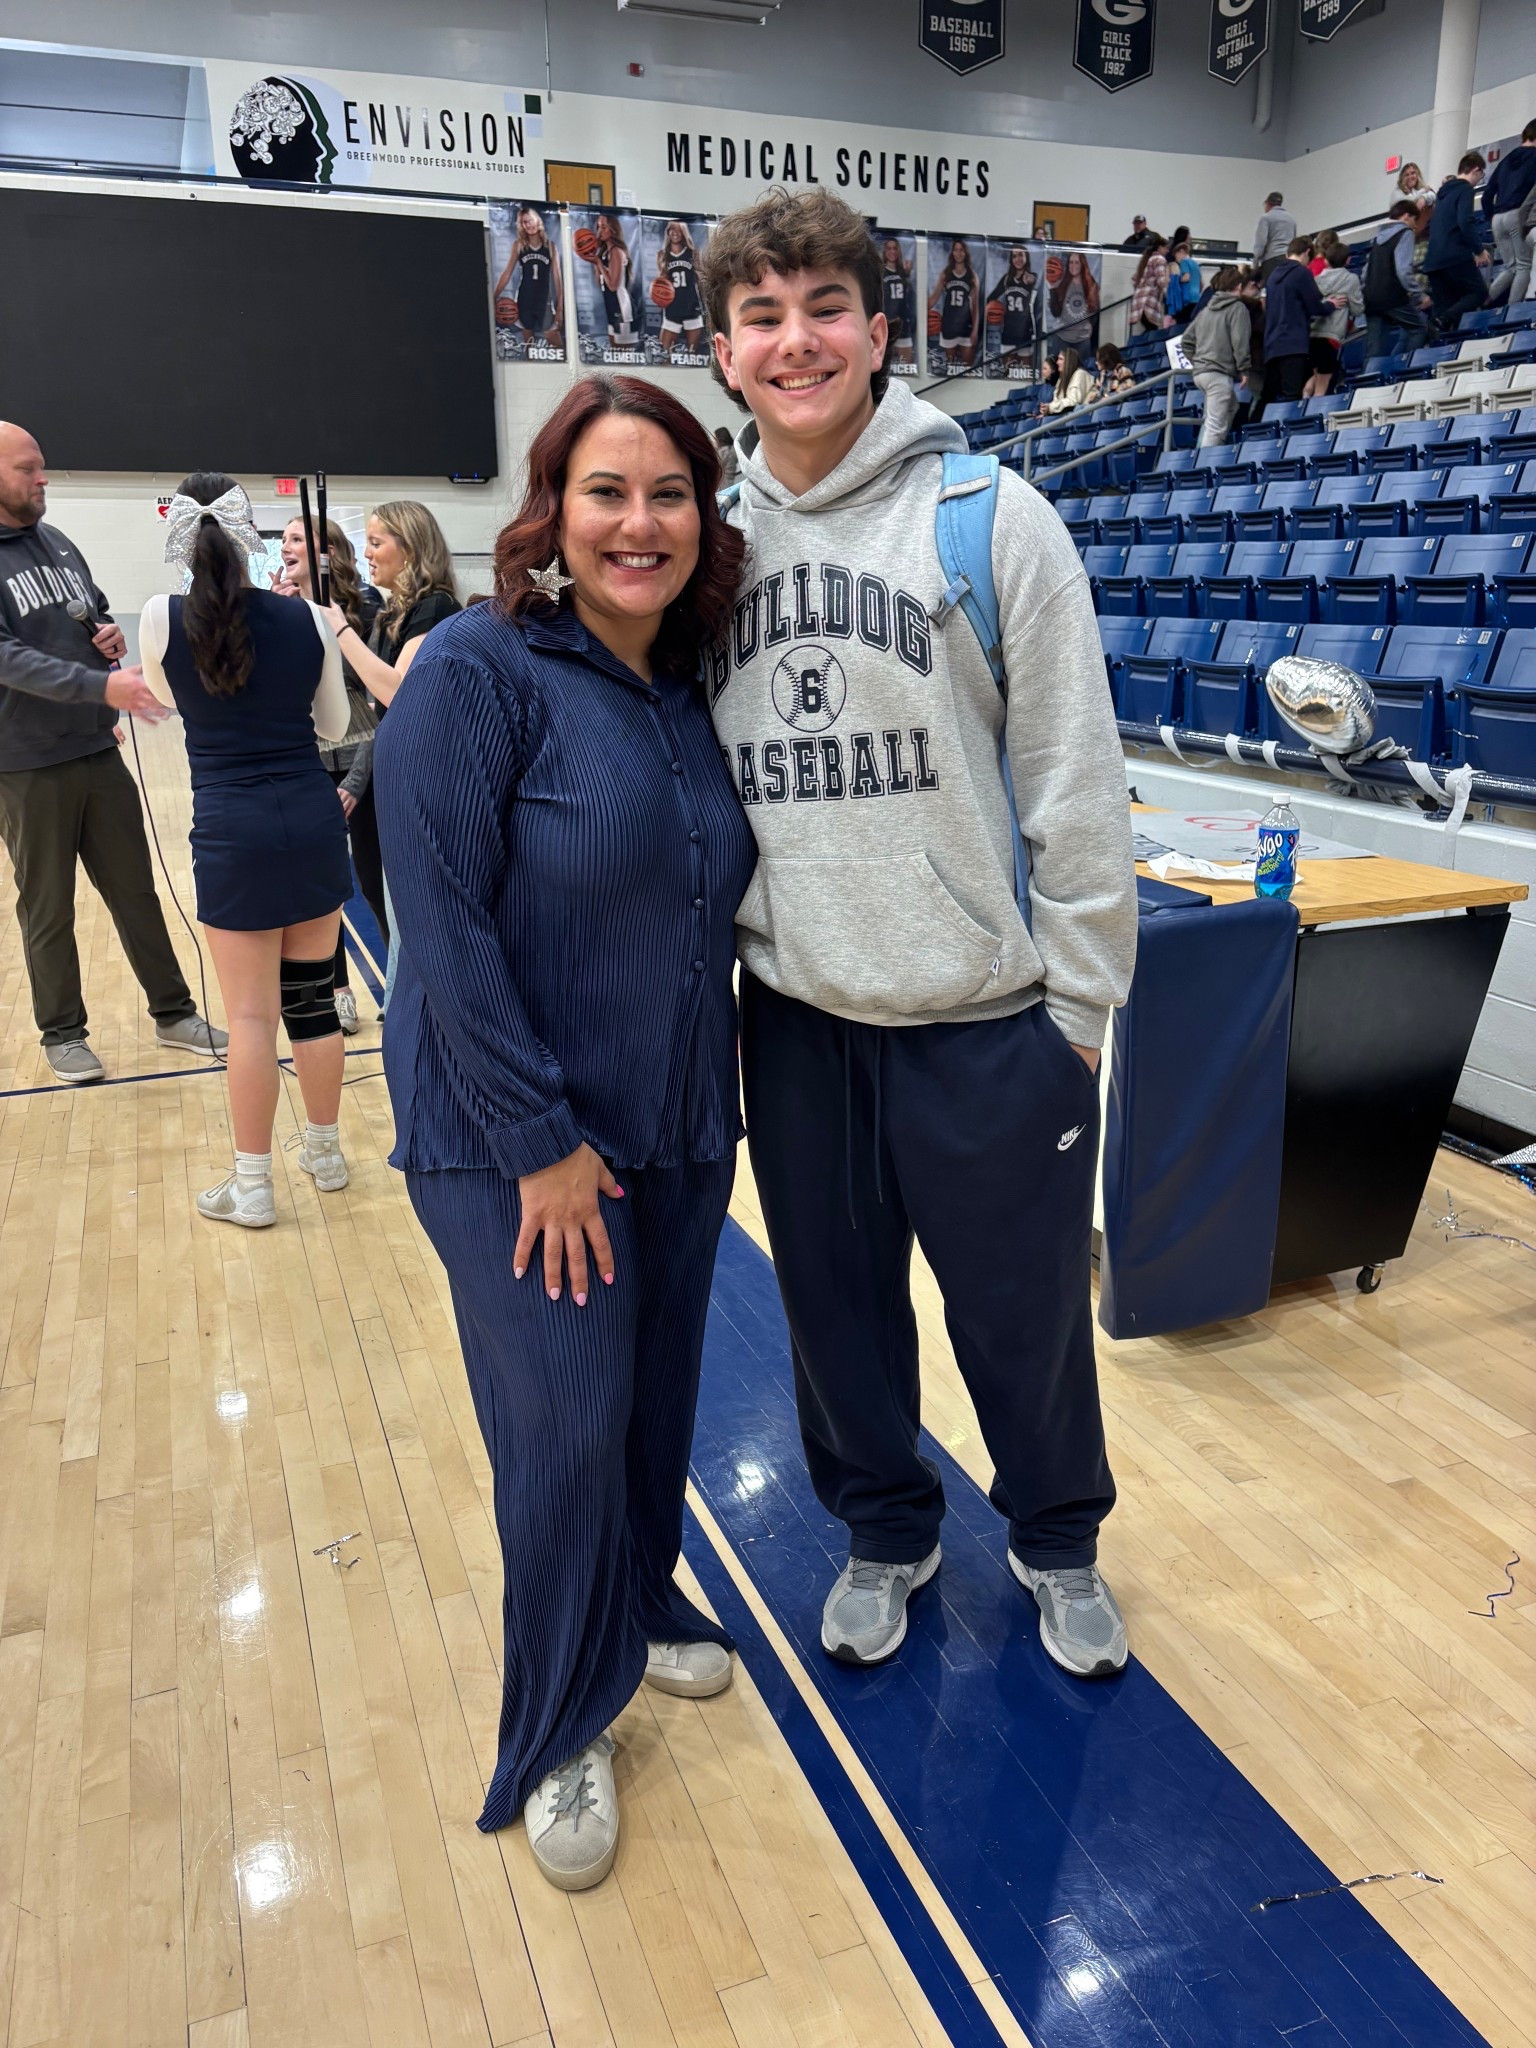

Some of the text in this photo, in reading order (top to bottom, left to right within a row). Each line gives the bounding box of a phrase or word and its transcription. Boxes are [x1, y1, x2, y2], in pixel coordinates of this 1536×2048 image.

[1317, 0, 1340, 23] 1999
[930, 15, 995, 39] BASEBALL
[1224, 19, 1248, 40] GIRLS
[949, 36, 976, 54] 1966
[1102, 30, 1131, 46] GIRLS
[1216, 32, 1255, 60] SOFTBALL
[1100, 45, 1132, 61] TRACK
[1226, 52, 1243, 71] 1998
[1104, 61, 1126, 76] 1982
[343, 100, 525, 158] ENVISION
[346, 150, 525, 174] GREENWOOD PROFESSIONAL STUDIES
[667, 131, 990, 198] MEDICAL SCIENCES
[532, 263, 539, 280] 1
[671, 270, 687, 288] 31
[890, 283, 904, 299] 12
[950, 289, 964, 306] 15
[1007, 295, 1024, 312] 34
[528, 348, 565, 361] ROSE
[603, 351, 646, 364] CLEMENTS
[670, 353, 710, 366] PEARCY
[6, 565, 94, 618] BULLDOGS
[708, 562, 933, 713] BULLDOG
[800, 668, 822, 714] 6
[1061, 1125, 1080, 1145] NIKE
